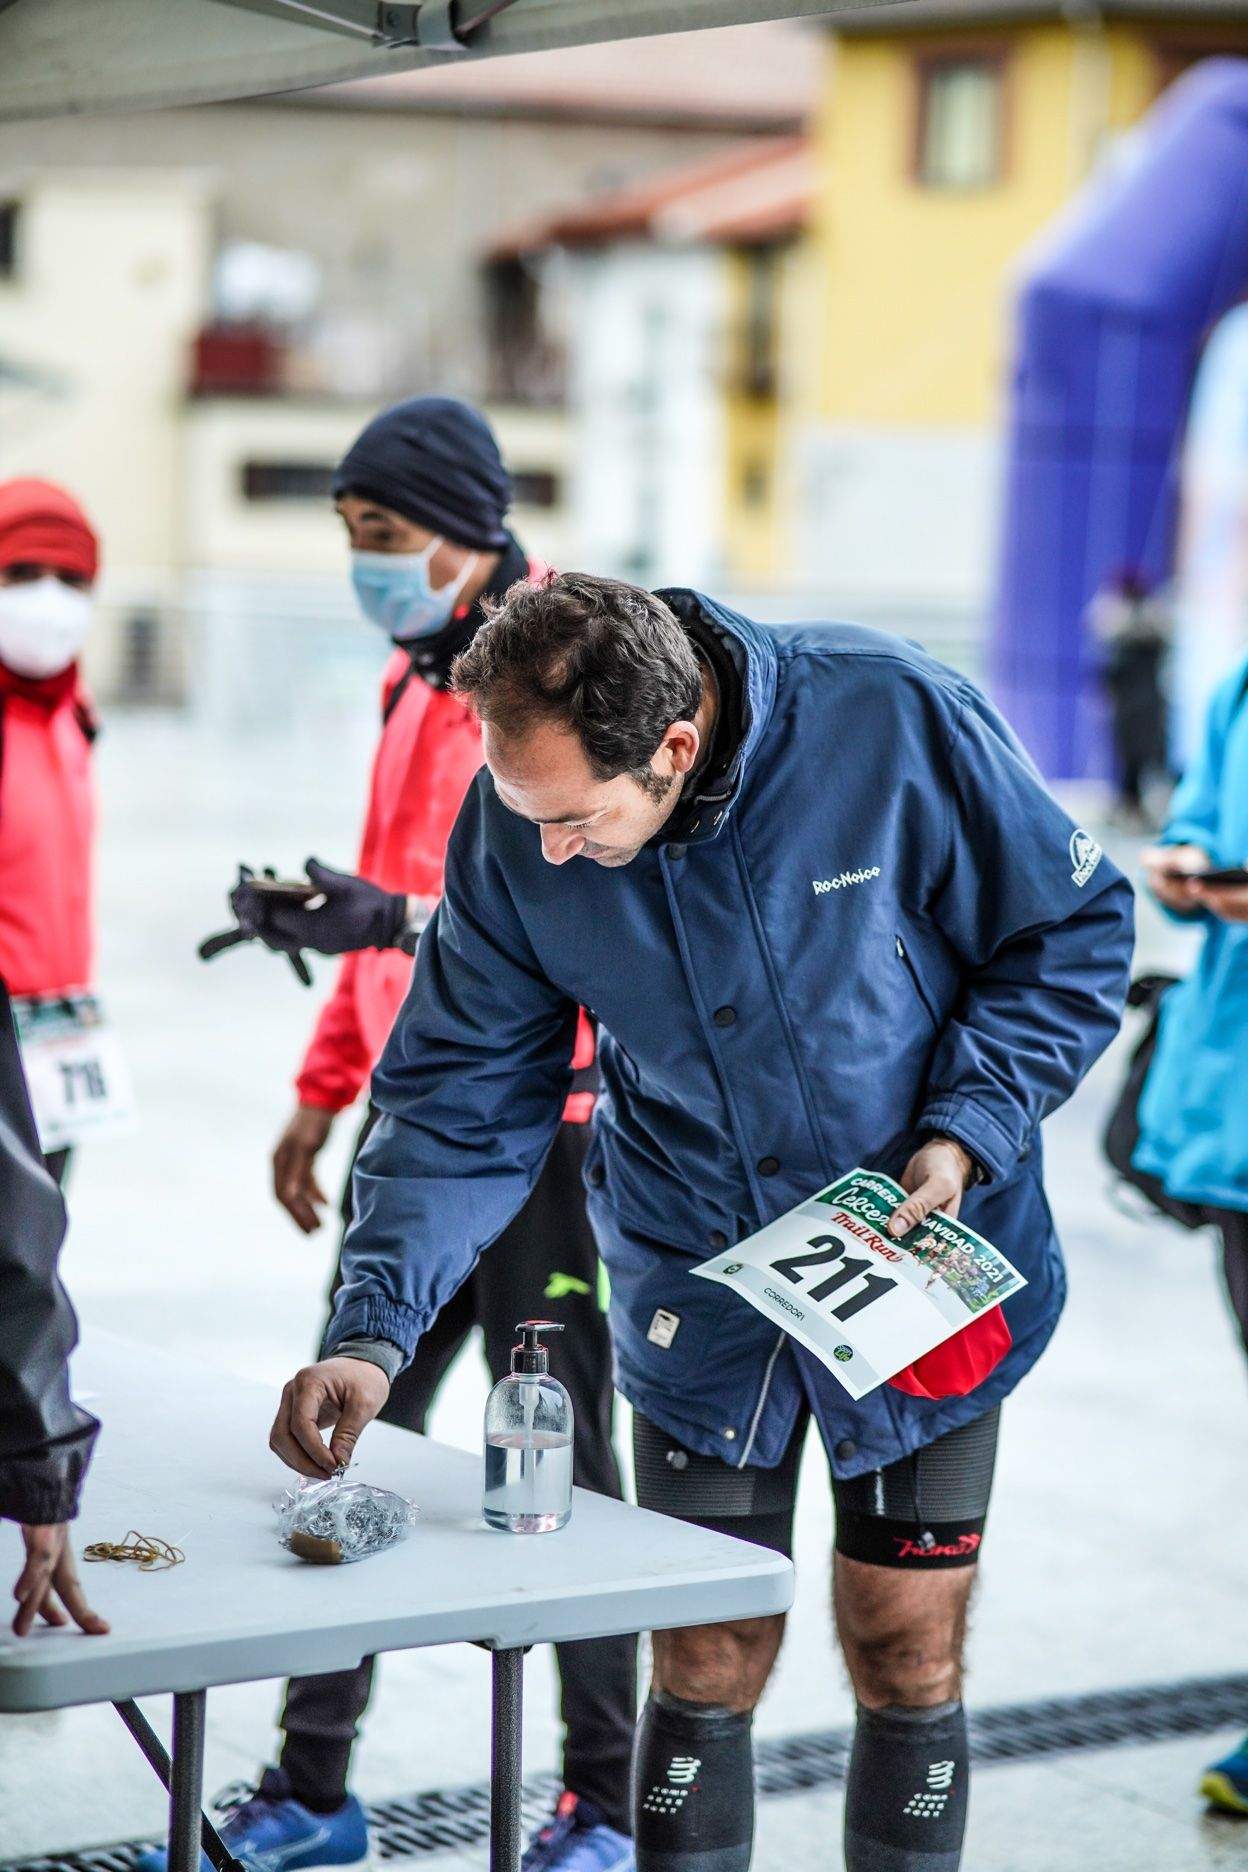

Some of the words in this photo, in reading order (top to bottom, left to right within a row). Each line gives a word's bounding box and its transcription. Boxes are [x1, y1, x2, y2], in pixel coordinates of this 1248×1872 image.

[831, 1211, 870, 1238] Trail
[862, 1232, 905, 1263] Run
[769, 1234, 899, 1323] 211
[973, 1254, 1004, 1284] 2021
